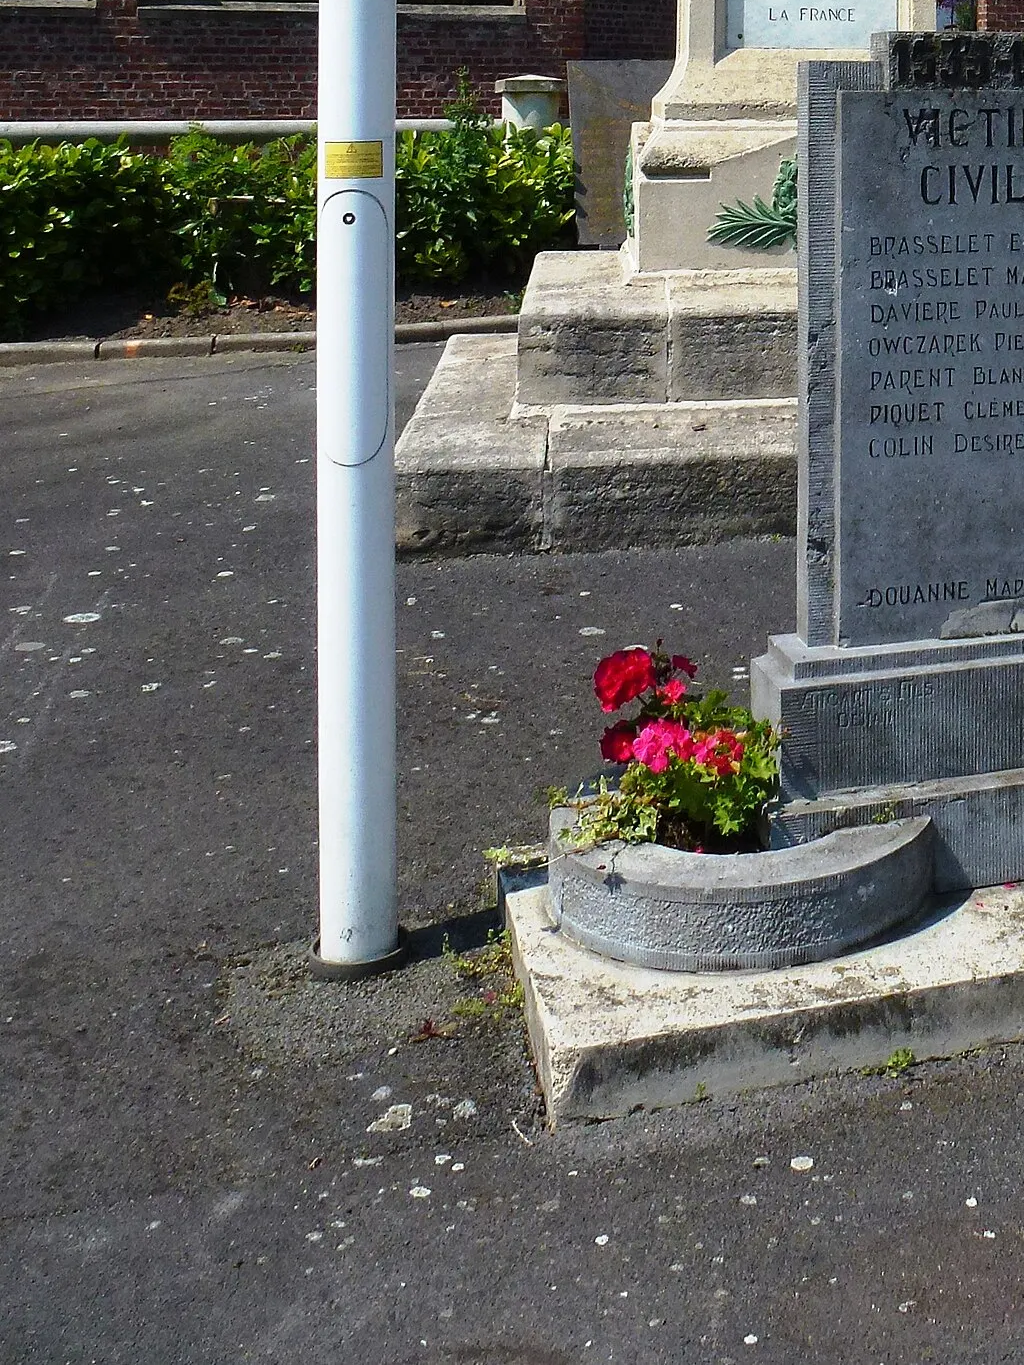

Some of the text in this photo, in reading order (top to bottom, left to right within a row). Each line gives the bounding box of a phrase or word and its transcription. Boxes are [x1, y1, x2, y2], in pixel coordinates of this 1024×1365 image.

[768, 7, 856, 22] LA FRANCE
[870, 233, 995, 259] BRASSELET
[870, 266, 994, 289] BRASSELET
[870, 300, 1024, 323] DAVIERE PAUL
[868, 333, 982, 357] OWCZAREK
[870, 367, 956, 394] PARENT
[870, 401, 945, 428] PIQUET
[868, 433, 1024, 458] COLIN DESIRE
[868, 581, 970, 608] DOUANNE
